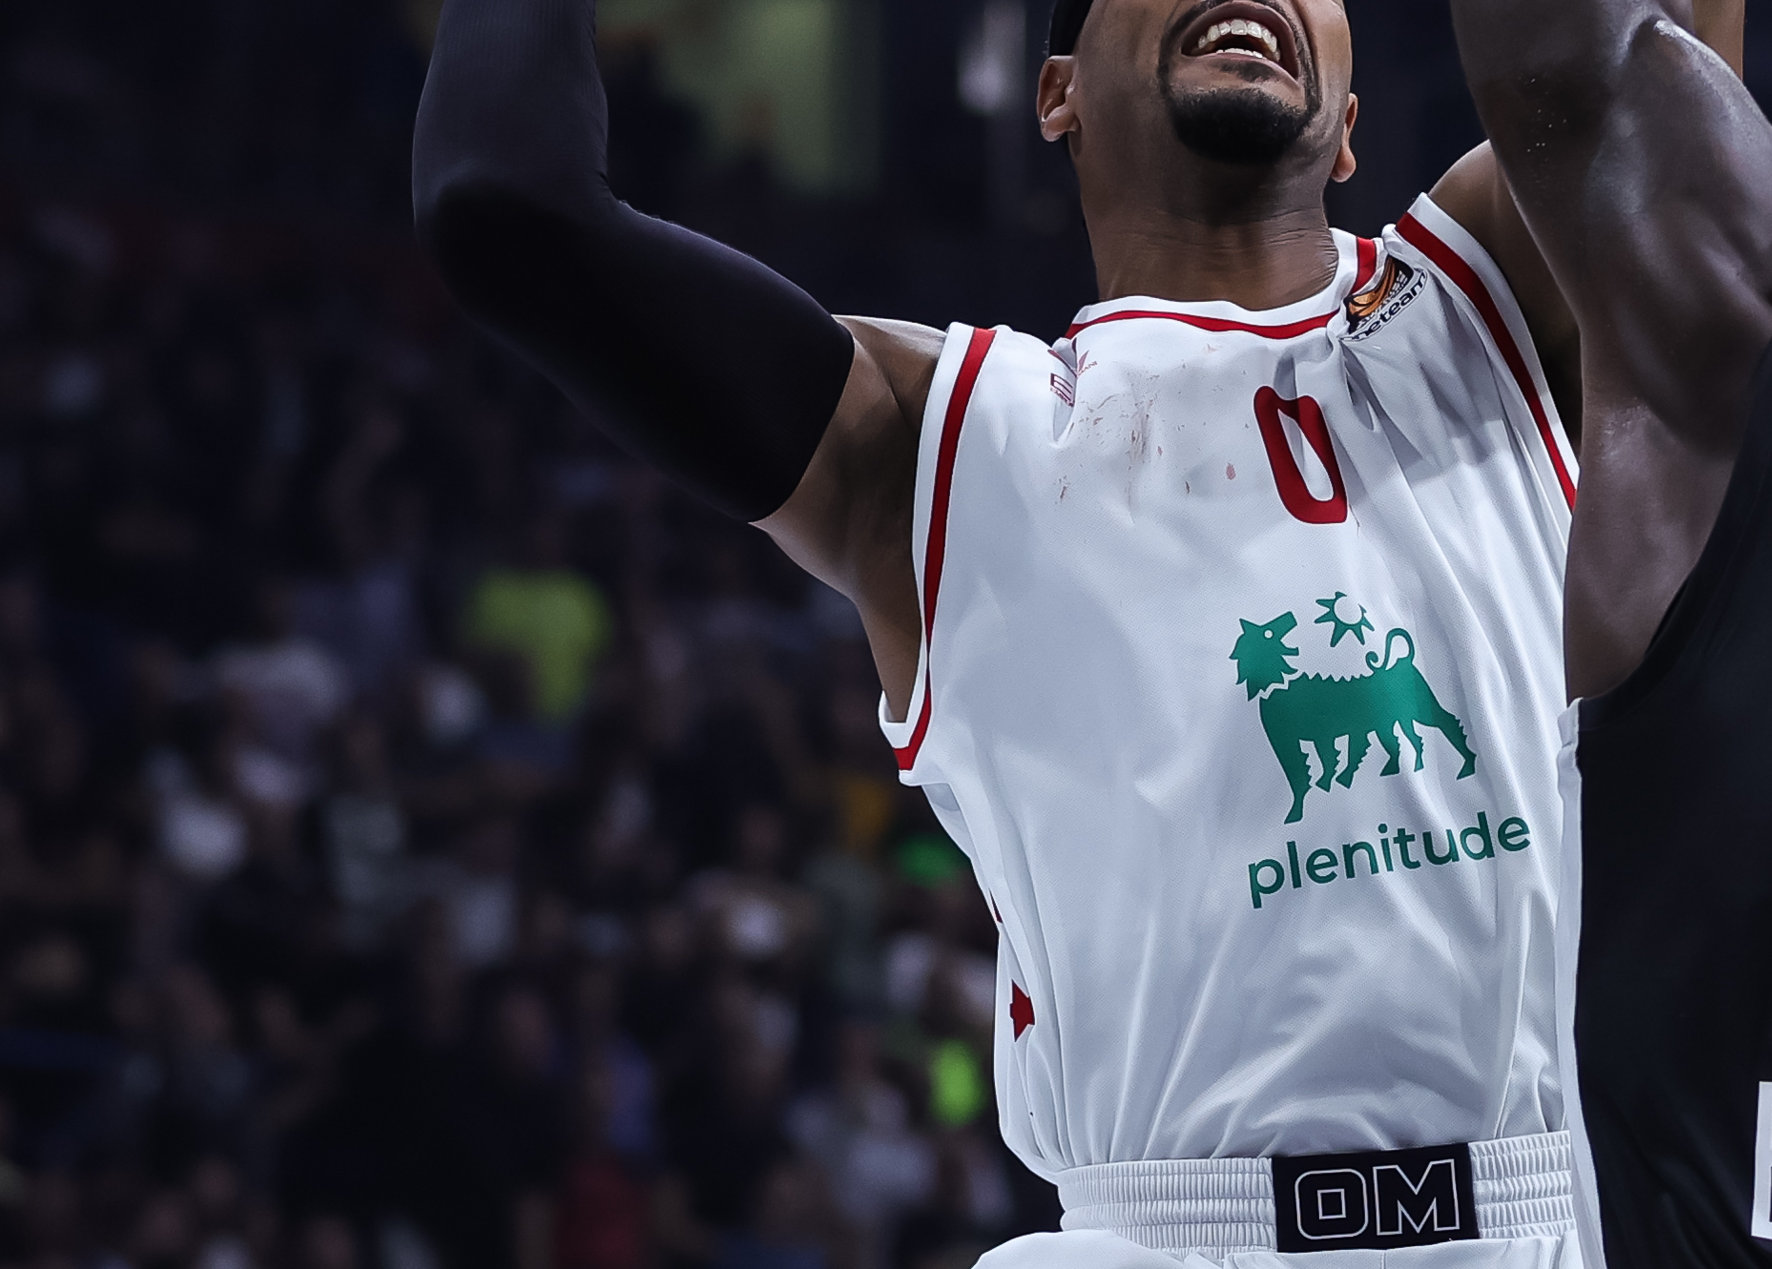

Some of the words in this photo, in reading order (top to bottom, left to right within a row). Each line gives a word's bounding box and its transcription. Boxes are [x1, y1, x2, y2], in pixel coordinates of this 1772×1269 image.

[1338, 268, 1426, 340] neteam
[1253, 385, 1348, 524] 0
[1247, 810, 1531, 909] plenitude
[1293, 1158, 1461, 1240] OM
